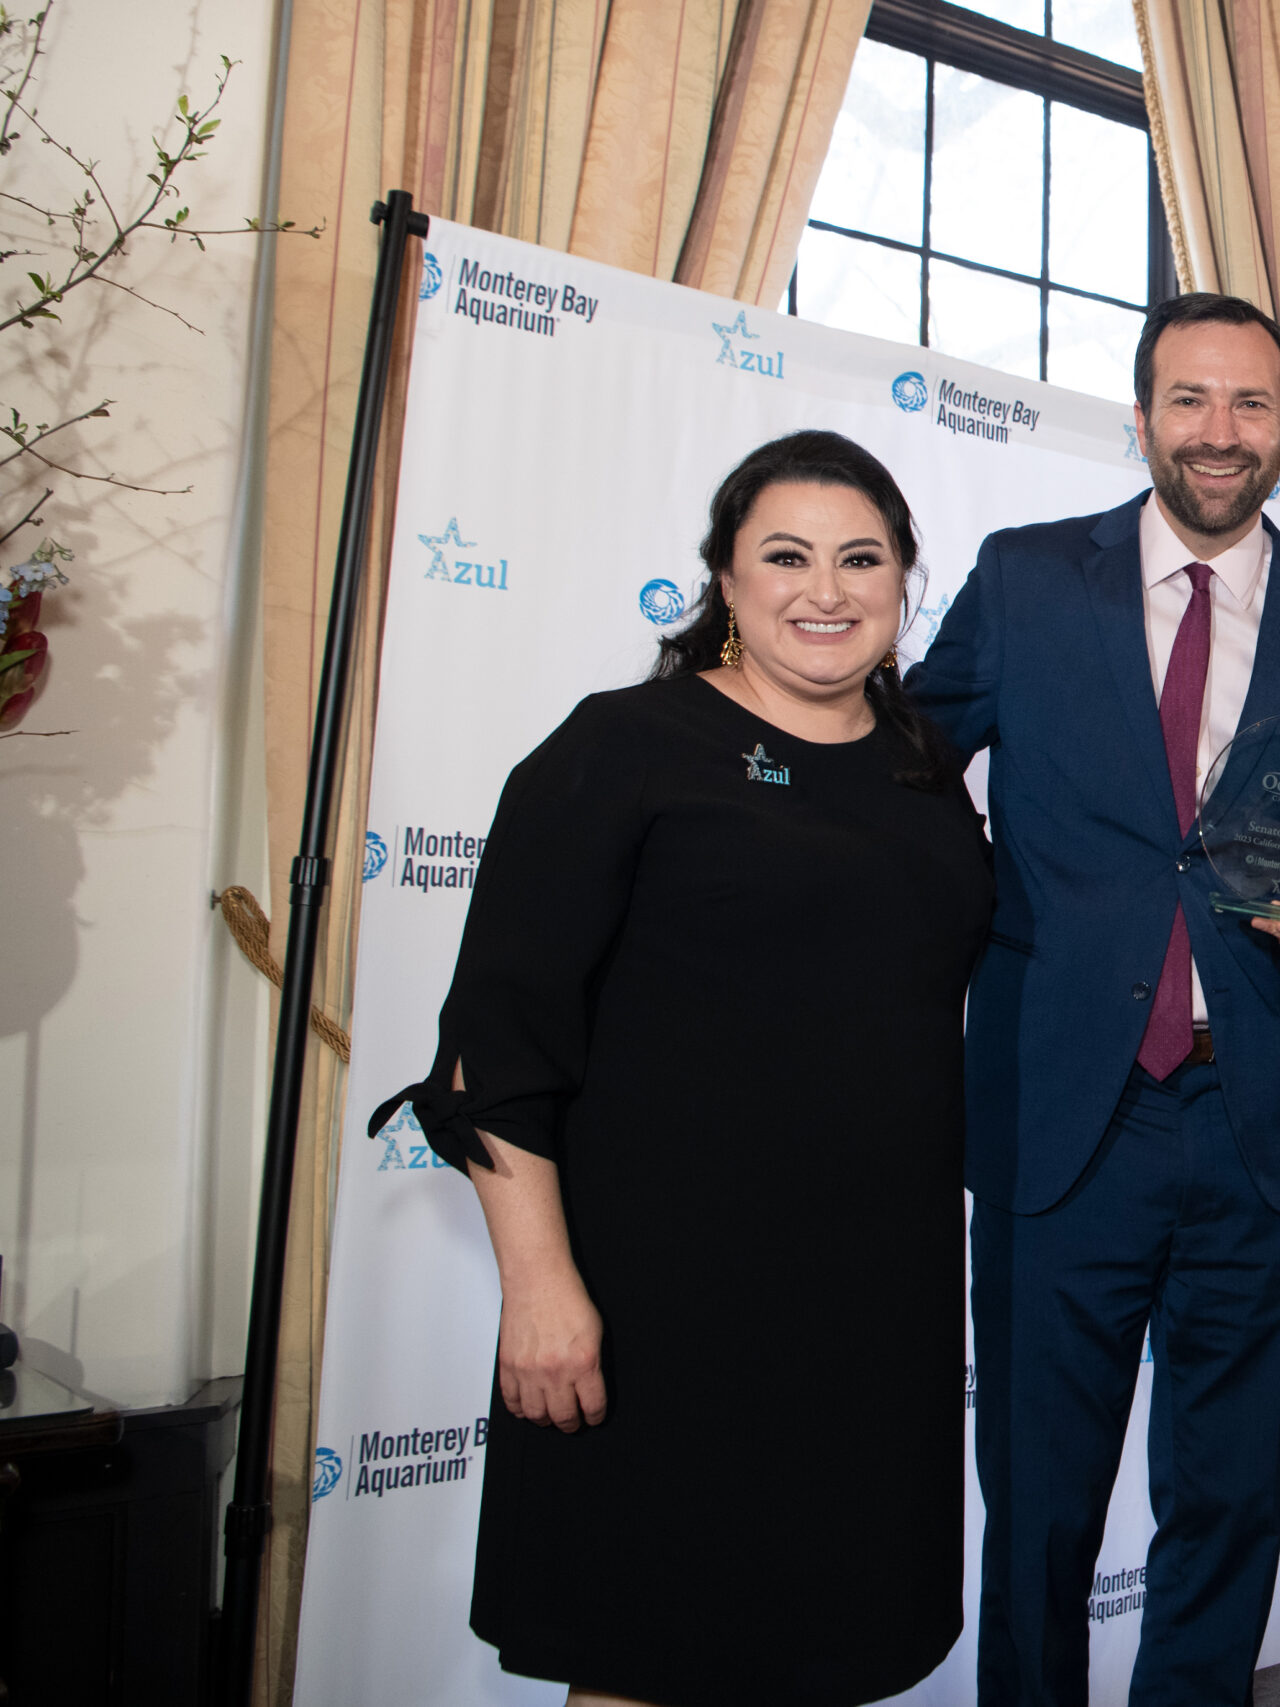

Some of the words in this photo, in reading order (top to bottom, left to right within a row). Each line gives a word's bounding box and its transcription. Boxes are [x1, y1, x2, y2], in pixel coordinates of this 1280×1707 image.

[458, 257, 558, 313] Monterey
[560, 284, 599, 323] Bay
[454, 287, 556, 337] Aquarium
[714, 332, 784, 379] Azul
[936, 403, 1009, 444] Aquarium
[938, 379, 1011, 424] Monterey
[1012, 400, 1040, 431] Bay
[422, 544, 508, 591] Azul
[746, 762, 791, 786] Azul
[404, 827, 487, 858] Monter
[400, 858, 474, 893] Aquari
[359, 1426, 471, 1464] Monterey
[354, 1455, 468, 1498] Aquarium
[1092, 1566, 1147, 1598] Montere
[1089, 1589, 1147, 1624] Aquariu
